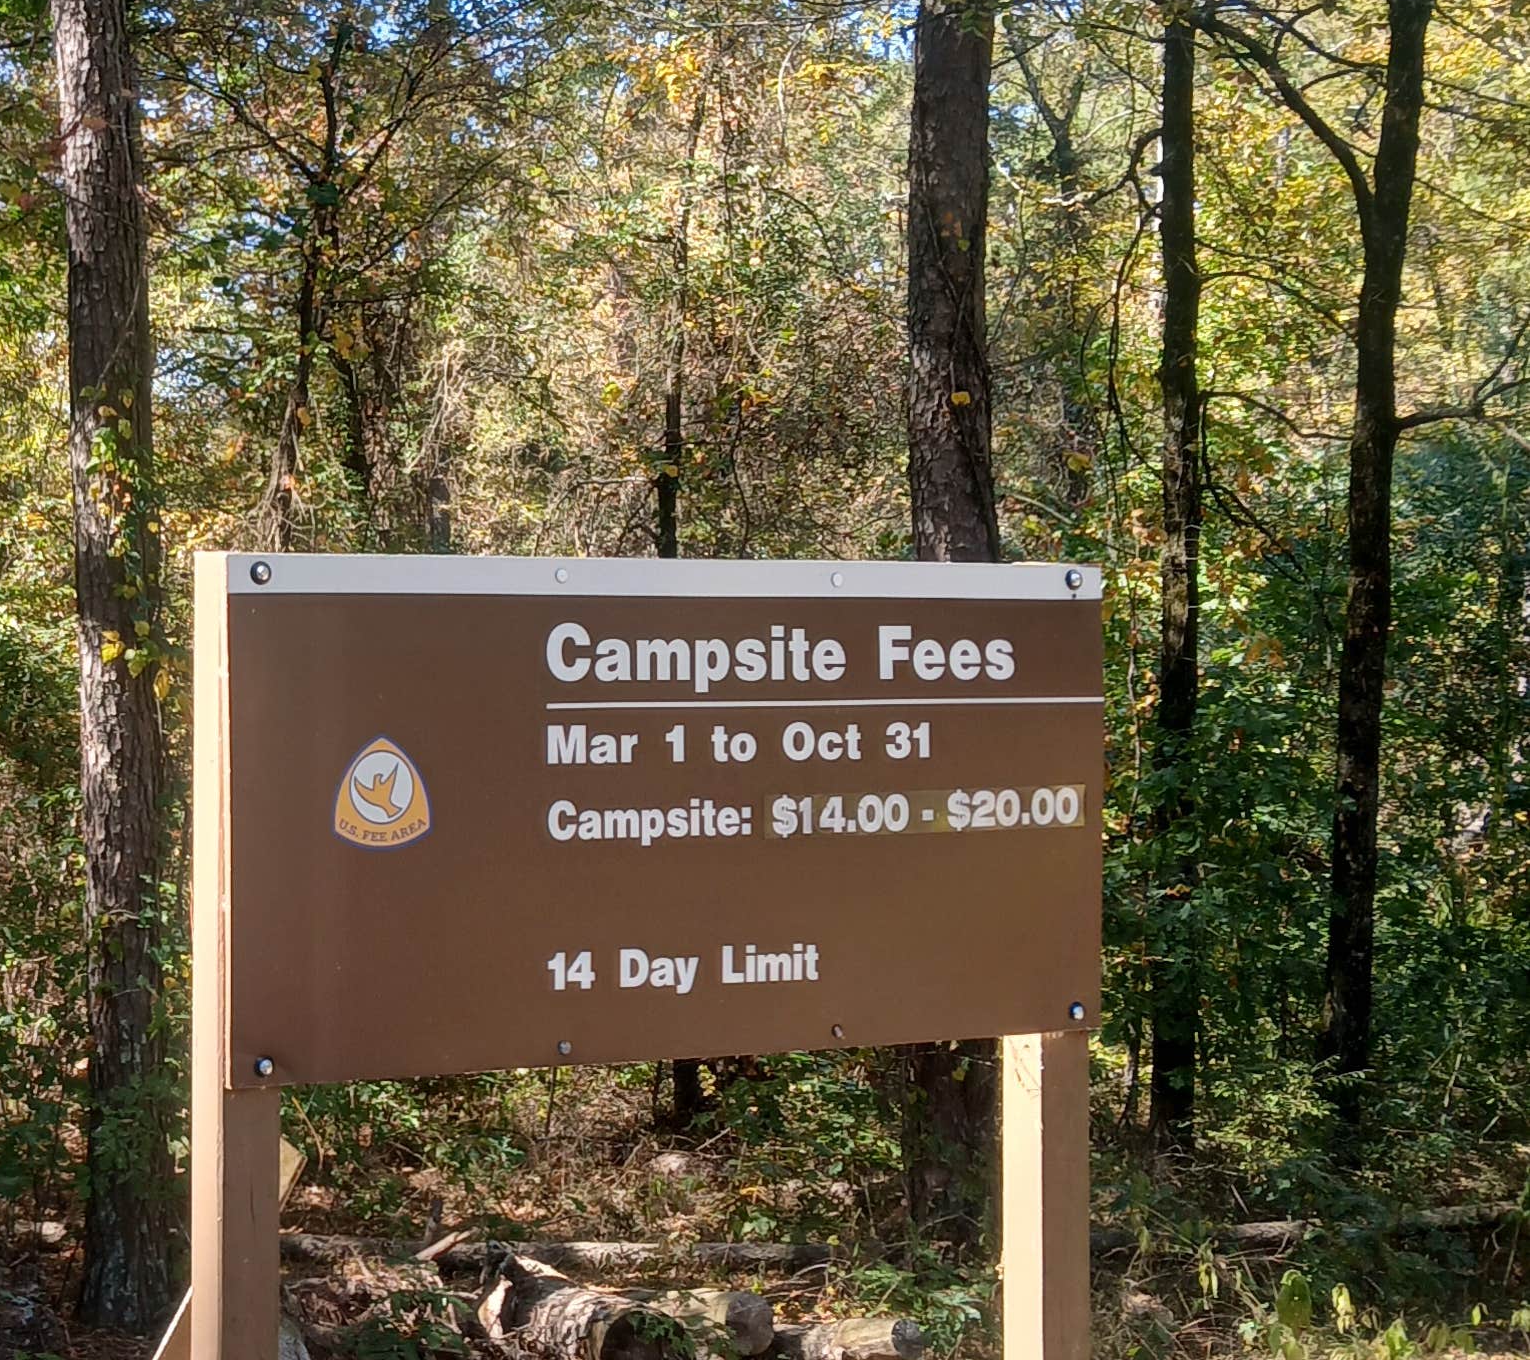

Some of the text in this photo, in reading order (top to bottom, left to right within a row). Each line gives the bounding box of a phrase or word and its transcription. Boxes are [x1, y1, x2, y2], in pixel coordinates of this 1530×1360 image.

[546, 622, 1016, 693] Campsite Fees
[547, 721, 931, 765] Mar 1 to Oct 31
[339, 818, 427, 842] U.S. FEE AREA
[547, 798, 752, 846] Campsite:
[771, 794, 909, 838] $14.00
[946, 786, 1079, 832] $20.00
[546, 943, 819, 994] 14 Day Limit
